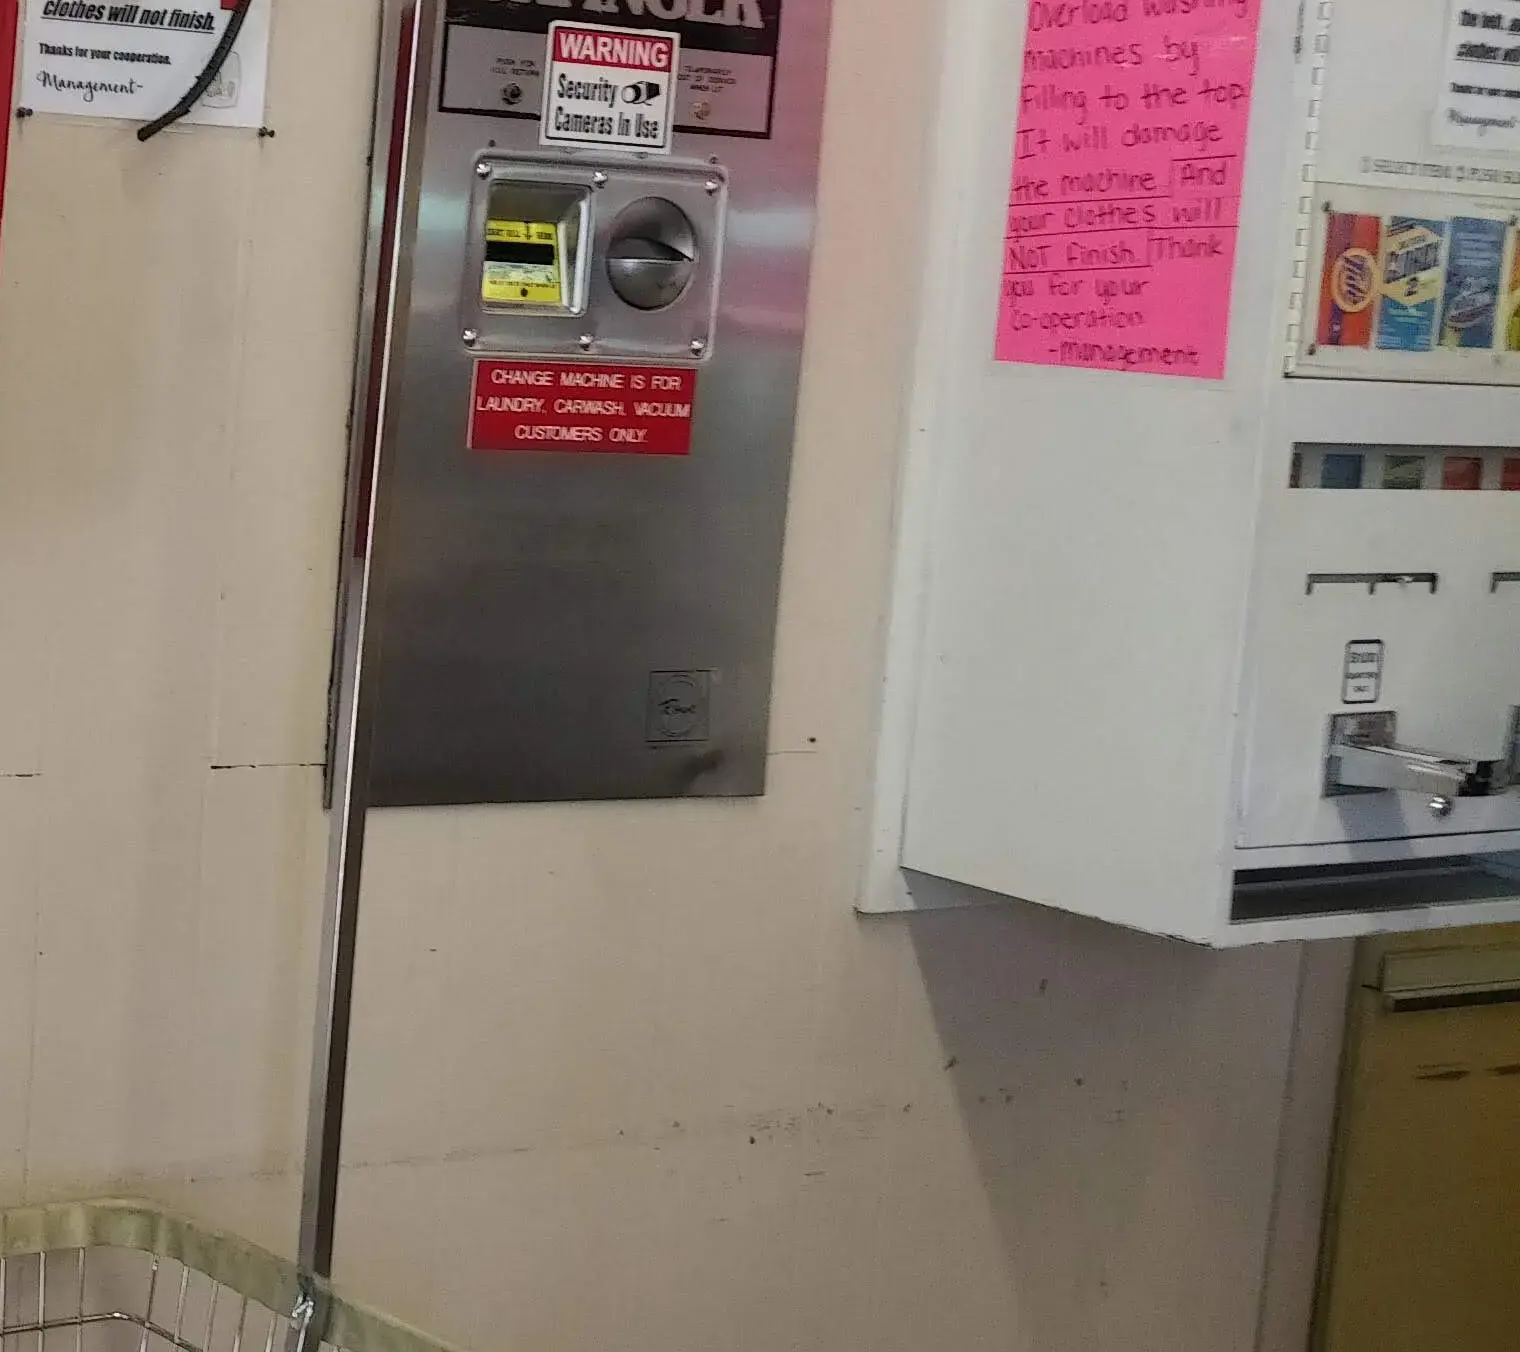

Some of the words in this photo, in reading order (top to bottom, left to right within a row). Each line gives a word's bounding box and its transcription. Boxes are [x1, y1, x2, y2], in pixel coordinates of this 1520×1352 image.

[108, 4, 139, 23] will
[139, 9, 167, 26] not
[39, 42, 72, 57] Thanks
[75, 45, 88, 59] for
[91, 49, 111, 61] your
[559, 31, 668, 68] WARNING
[1165, 34, 1199, 76] by
[557, 73, 618, 108] Security
[1098, 84, 1129, 111] to
[1140, 83, 1189, 110] the
[1197, 79, 1247, 110] top
[555, 106, 613, 135] Cameras
[618, 112, 630, 137] In
[635, 113, 658, 139] Use
[1062, 125, 1108, 152] will
[1120, 120, 1224, 152] damage
[491, 369, 554, 386] CHANGE
[560, 371, 625, 389] MACHINE
[631, 375, 646, 390] IS
[651, 375, 683, 391] FOR
[633, 401, 691, 418] VACUUM
[514, 424, 603, 442] CUSTOMERS
